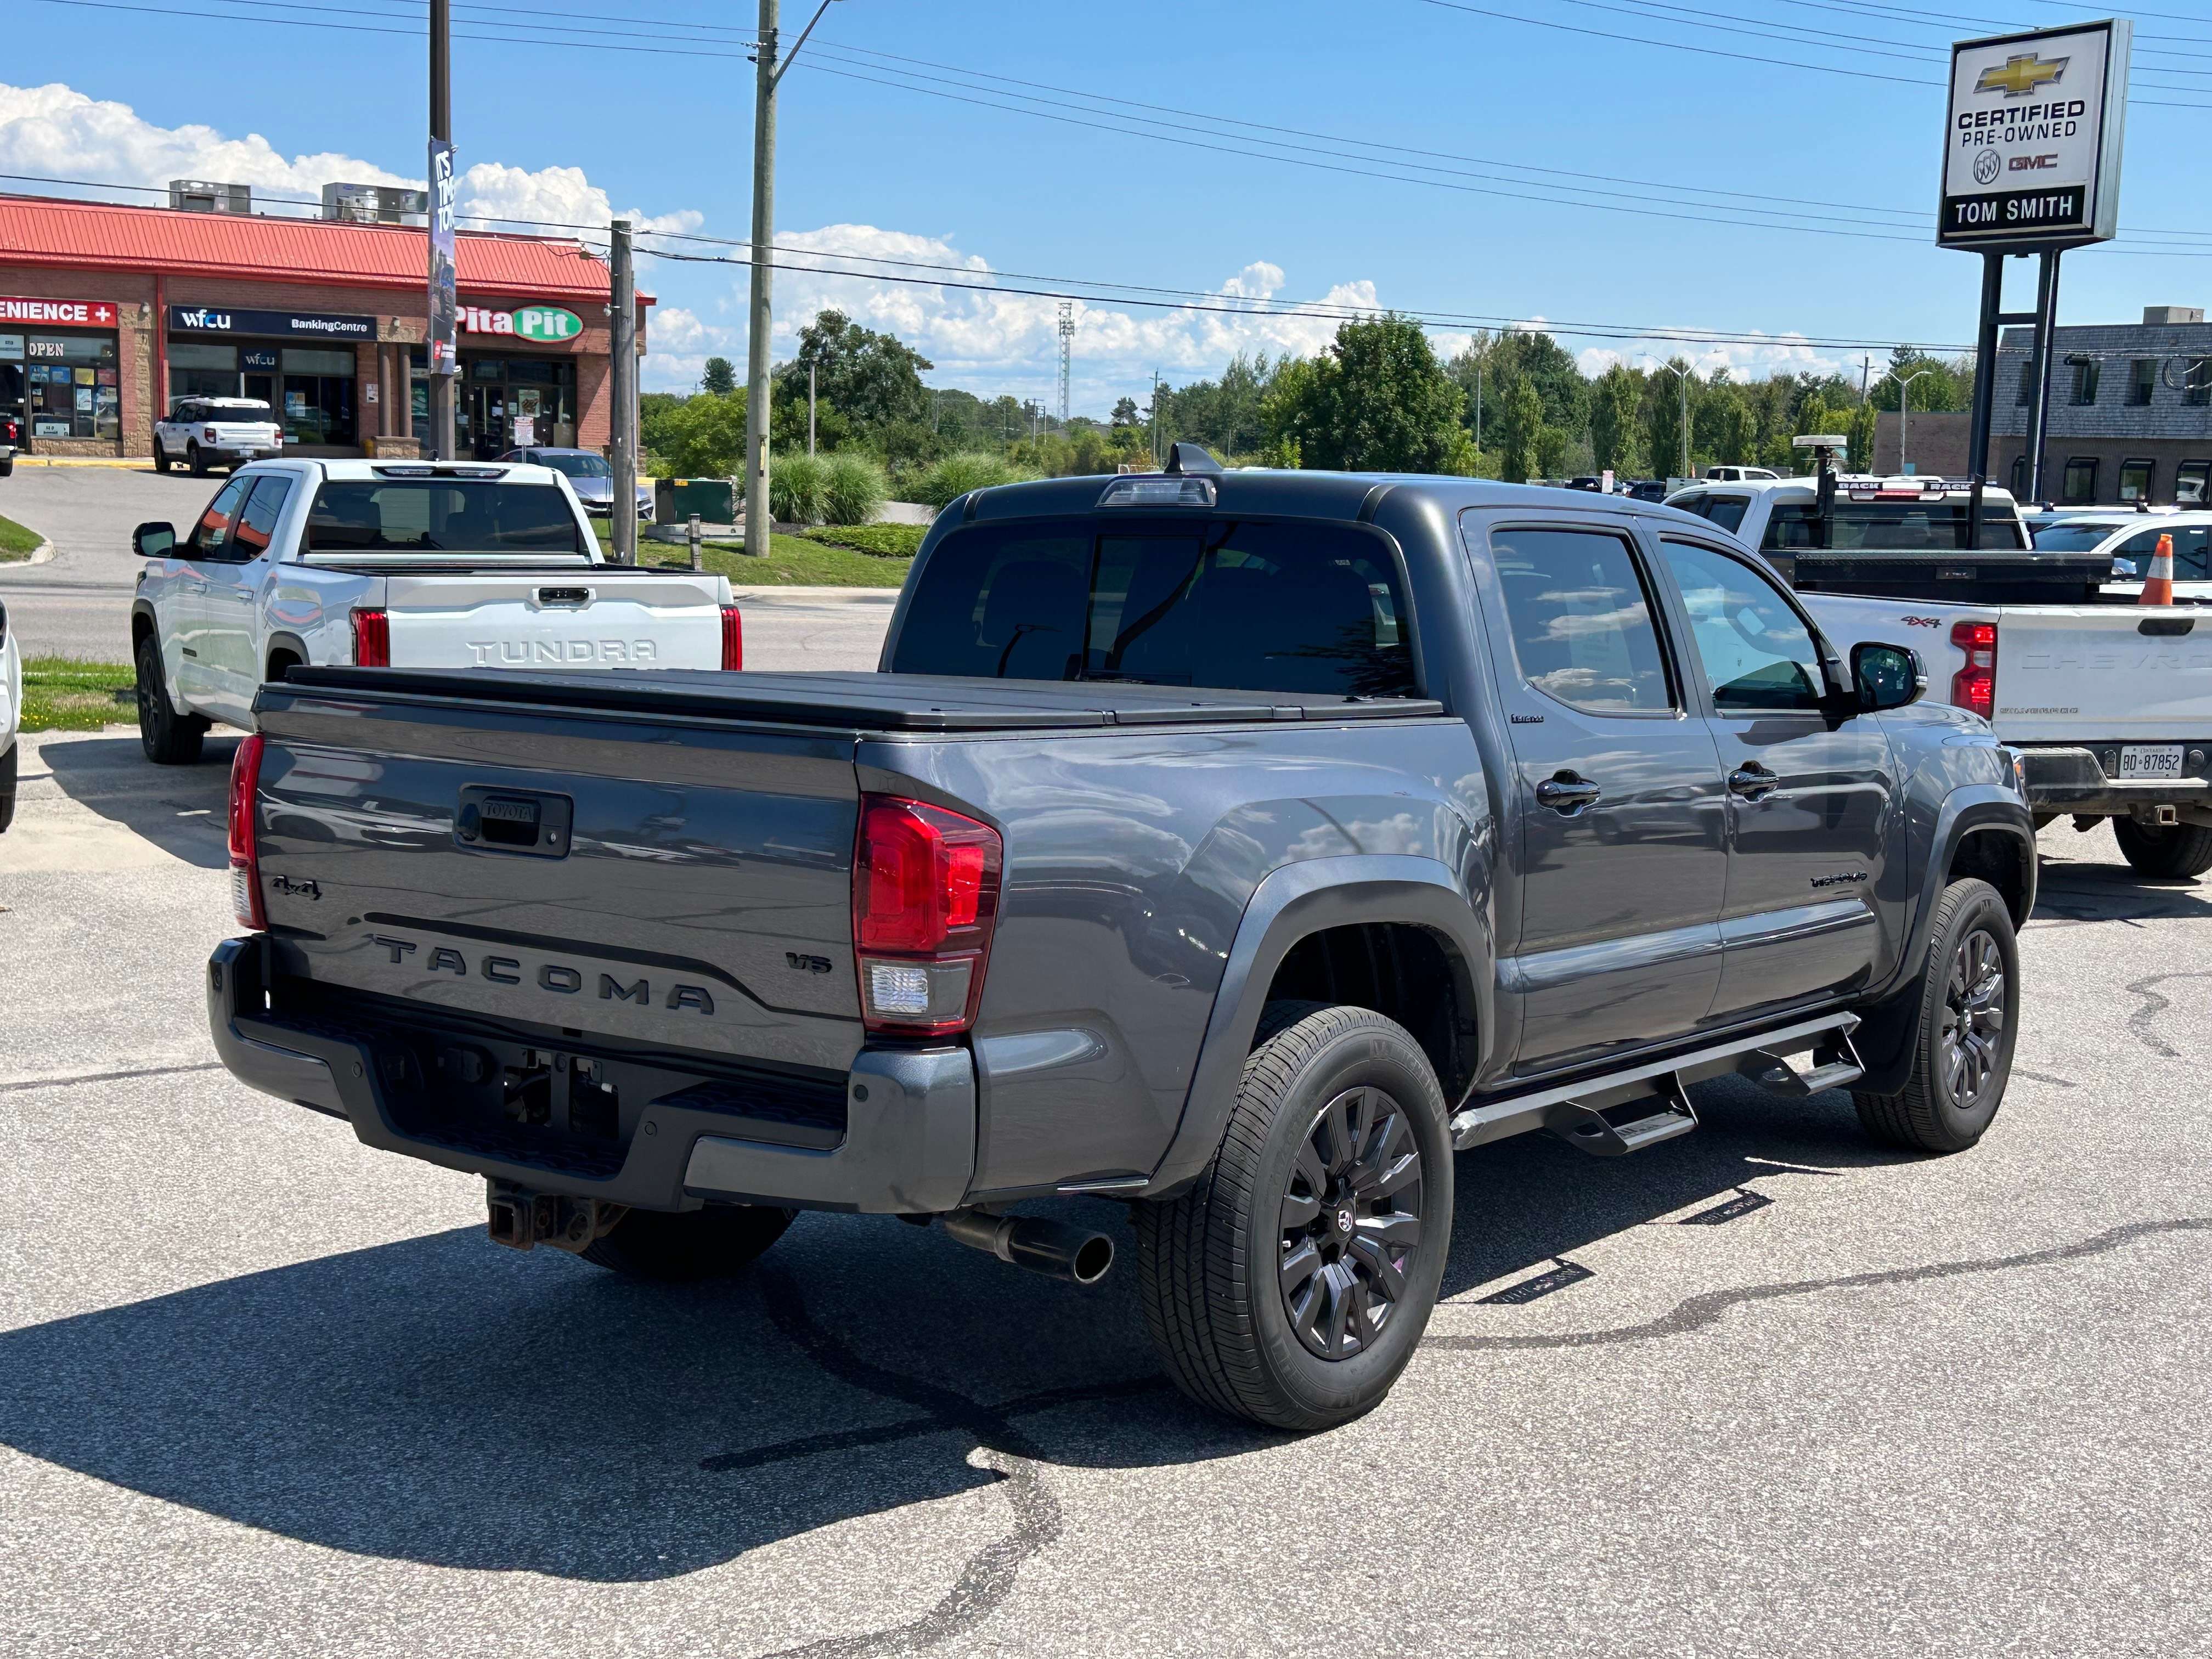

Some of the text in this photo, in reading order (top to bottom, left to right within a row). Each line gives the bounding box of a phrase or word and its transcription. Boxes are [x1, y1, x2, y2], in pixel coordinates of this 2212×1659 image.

[1958, 100, 2085, 130] CERTIFIED
[1962, 121, 2076, 148] PRE-OWNED
[2008, 154, 2058, 171] GMC
[1956, 195, 2073, 224] TOM SMITH
[181, 309, 368, 332] wfcu BankingCentre
[455, 306, 568, 337] Pita Pit
[29, 342, 64, 357] OPEN
[245, 353, 274, 365] wfcu
[466, 639, 657, 664] TUNDRA
[2143, 754, 2180, 770] 87852
[485, 802, 534, 821] TOYOTA
[785, 952, 833, 973] V6
[373, 935, 715, 1015] TACOMA
